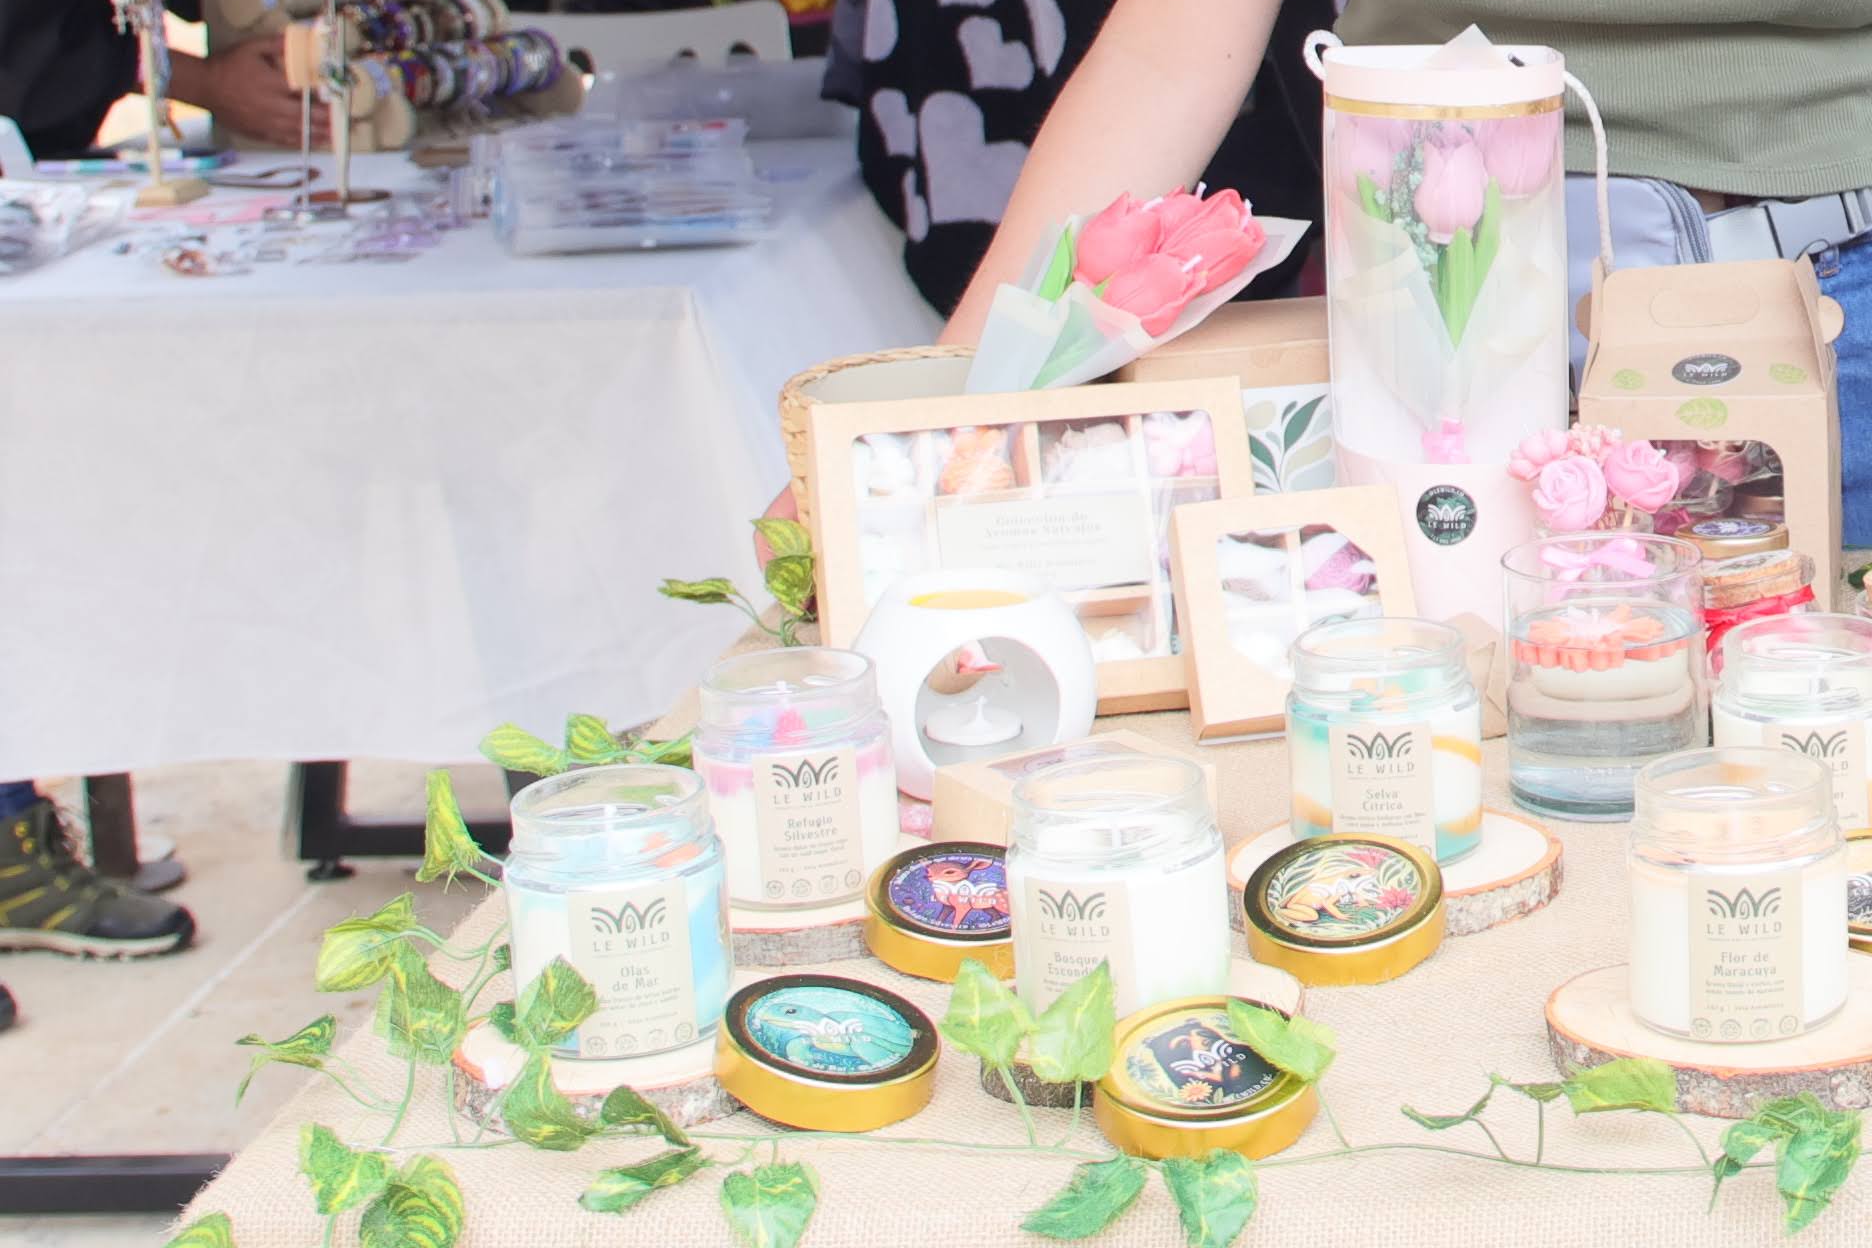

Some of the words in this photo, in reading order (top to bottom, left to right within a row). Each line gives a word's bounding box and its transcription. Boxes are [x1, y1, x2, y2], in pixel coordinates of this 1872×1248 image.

[1443, 521, 1467, 530] WILD
[1346, 763, 1365, 775] LE
[1376, 761, 1415, 774] WILD
[773, 793, 792, 805] LE
[802, 787, 842, 803] WILD
[1366, 788, 1399, 800] Selva
[787, 815, 833, 830] Refugio
[784, 827, 838, 842] Silvestre
[958, 894, 997, 905] WILD
[1040, 922, 1057, 936] LE
[1066, 925, 1111, 937] WILD
[1706, 923, 1727, 935] LE
[1738, 921, 1783, 935] WILD
[592, 940, 614, 953] LE
[626, 931, 671, 949] WILD
[1055, 952, 1099, 968] Bosque
[1720, 951, 1747, 963] Flor
[1753, 951, 1770, 963] de
[620, 965, 650, 978] Olas
[611, 980, 629, 993] de
[635, 975, 660, 990] Mar
